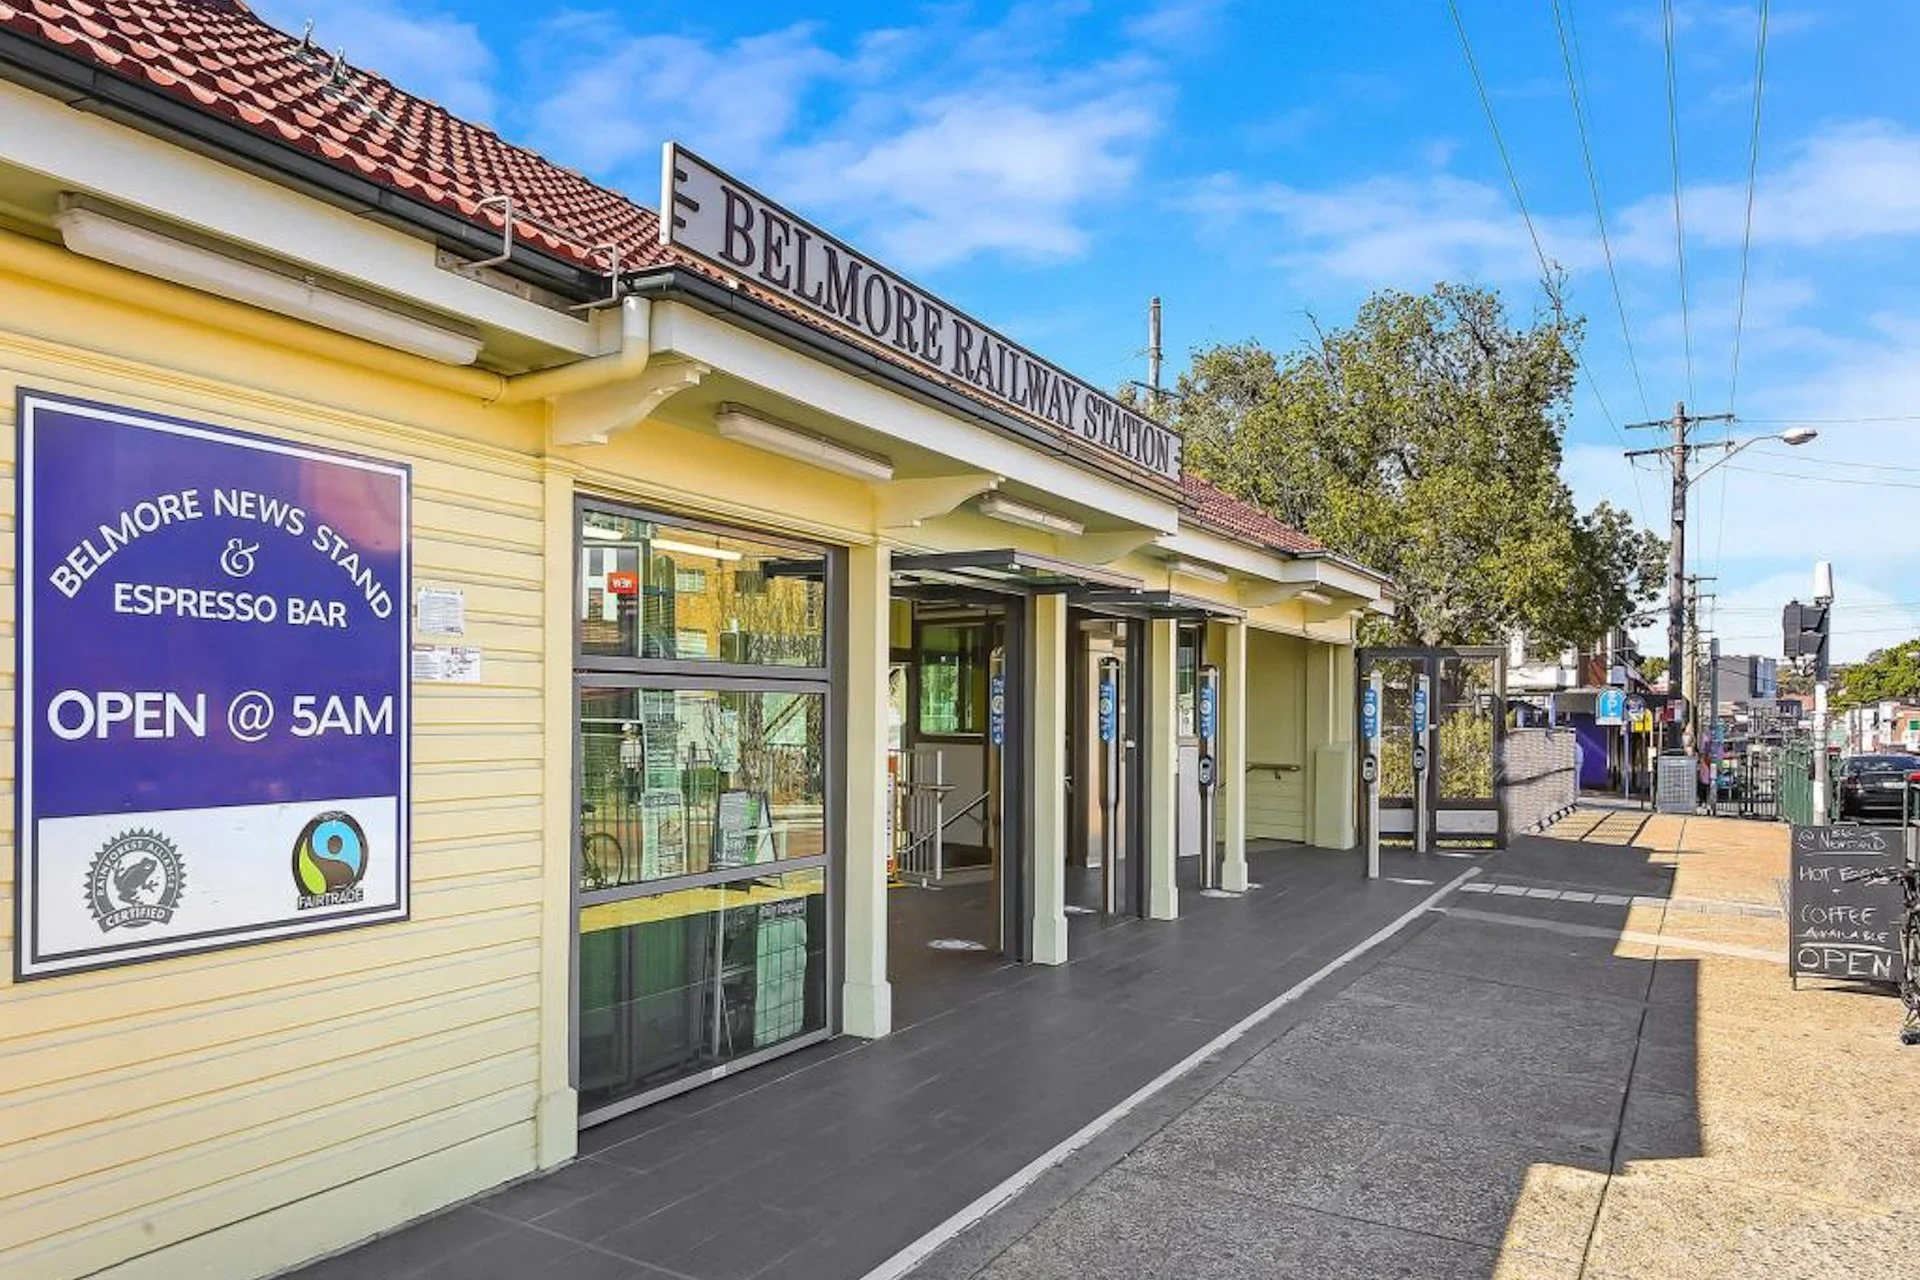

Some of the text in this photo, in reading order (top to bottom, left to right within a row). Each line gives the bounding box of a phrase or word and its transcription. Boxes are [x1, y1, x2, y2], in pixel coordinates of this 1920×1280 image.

[719, 186, 1169, 474] BELMORE RAILWAY STATION
[49, 489, 203, 599] BELMORE
[213, 488, 306, 536] NEWS
[312, 525, 393, 620] STAND
[220, 538, 259, 577] &
[114, 582, 348, 629] ESPRESSO BAR
[47, 689, 394, 742] OPEN @ 5AM
[1799, 865, 1835, 882] HOT
[105, 907, 166, 927] CERTIFIED
[298, 888, 364, 911] FAIRTRADE
[1801, 904, 1877, 926] COFFEE
[1797, 947, 1893, 978] OPEN
